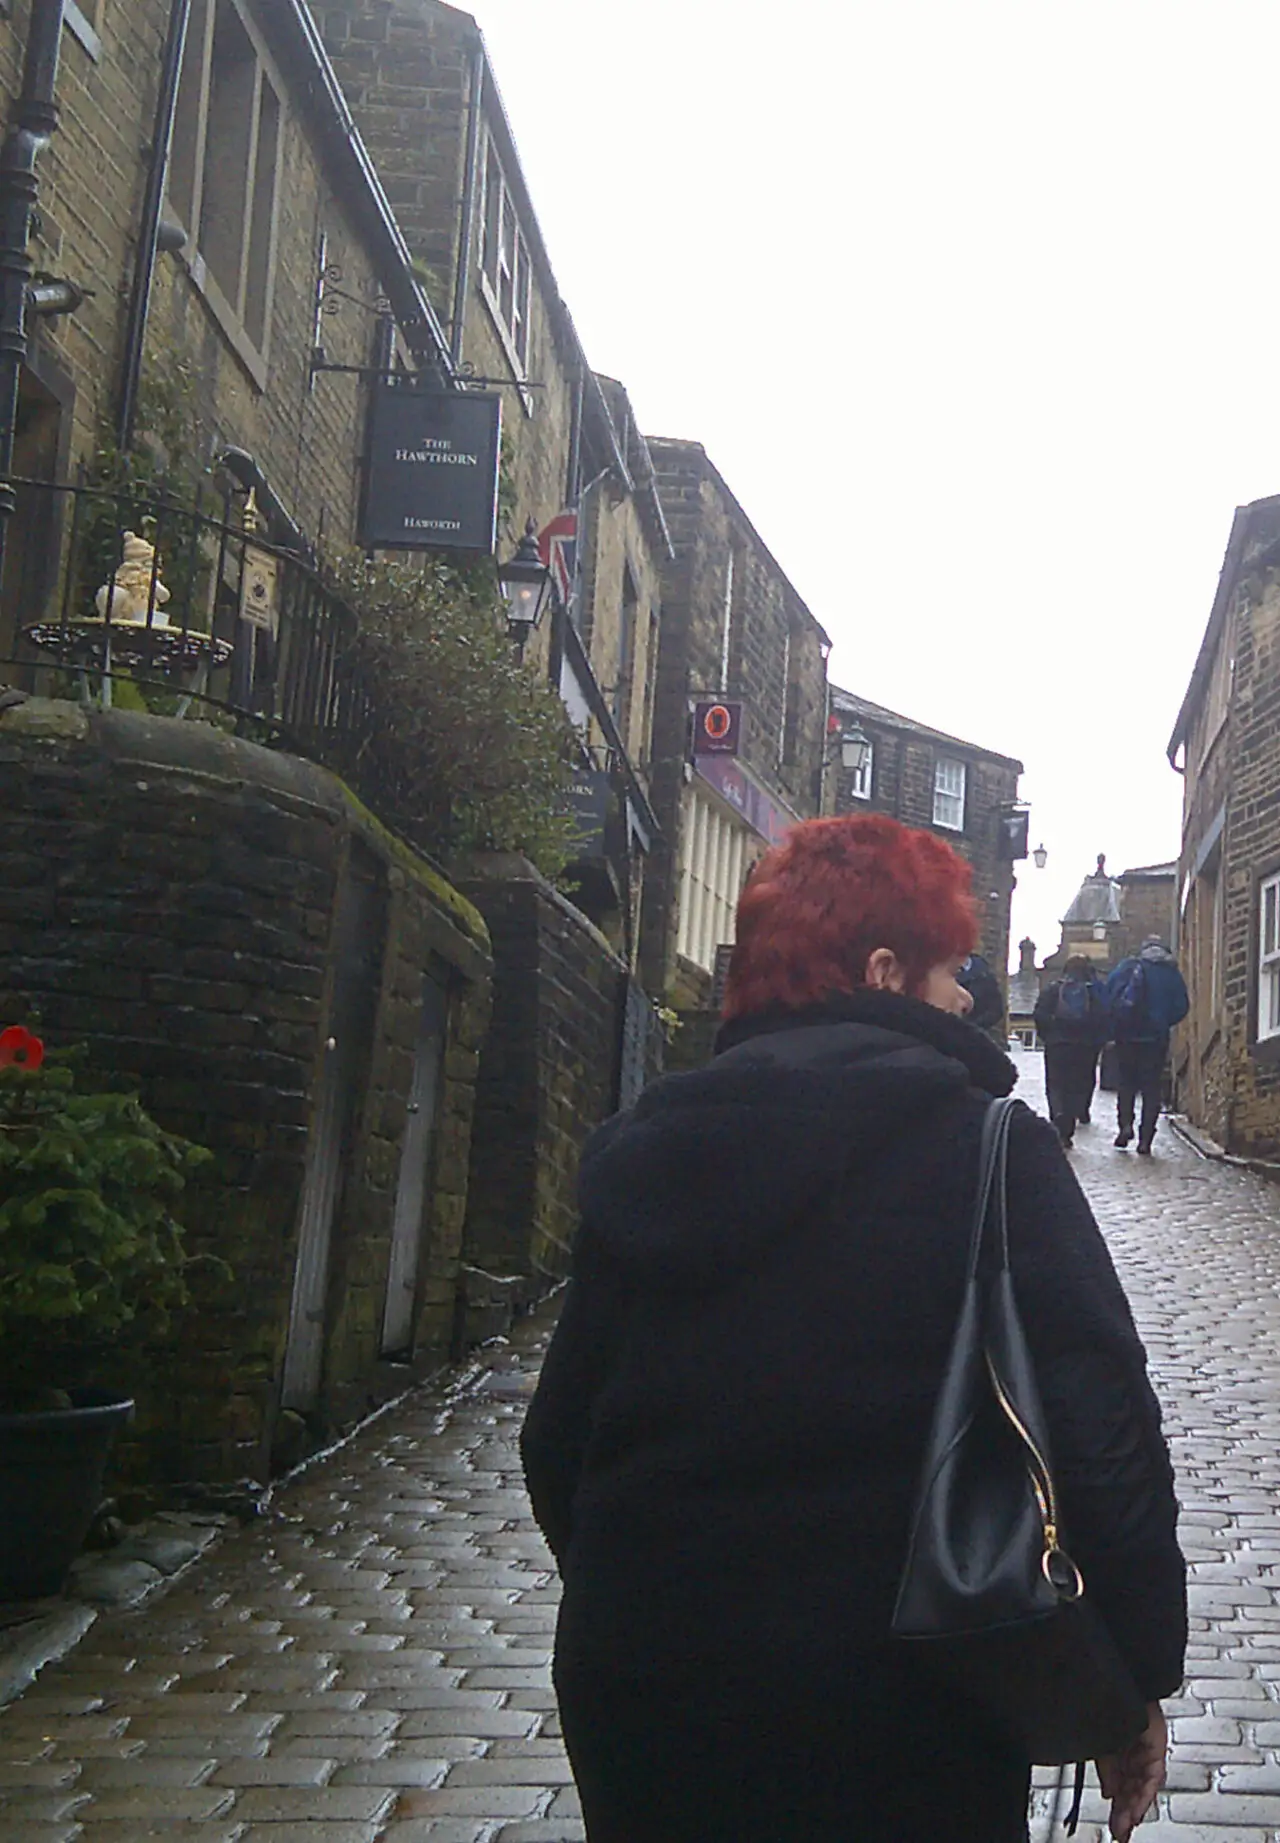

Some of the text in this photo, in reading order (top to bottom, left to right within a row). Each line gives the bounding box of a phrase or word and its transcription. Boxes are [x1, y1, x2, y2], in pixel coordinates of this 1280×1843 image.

[423, 438, 452, 449] THE
[395, 448, 477, 466] HAWTHORN
[404, 516, 461, 530] HAWORTH
